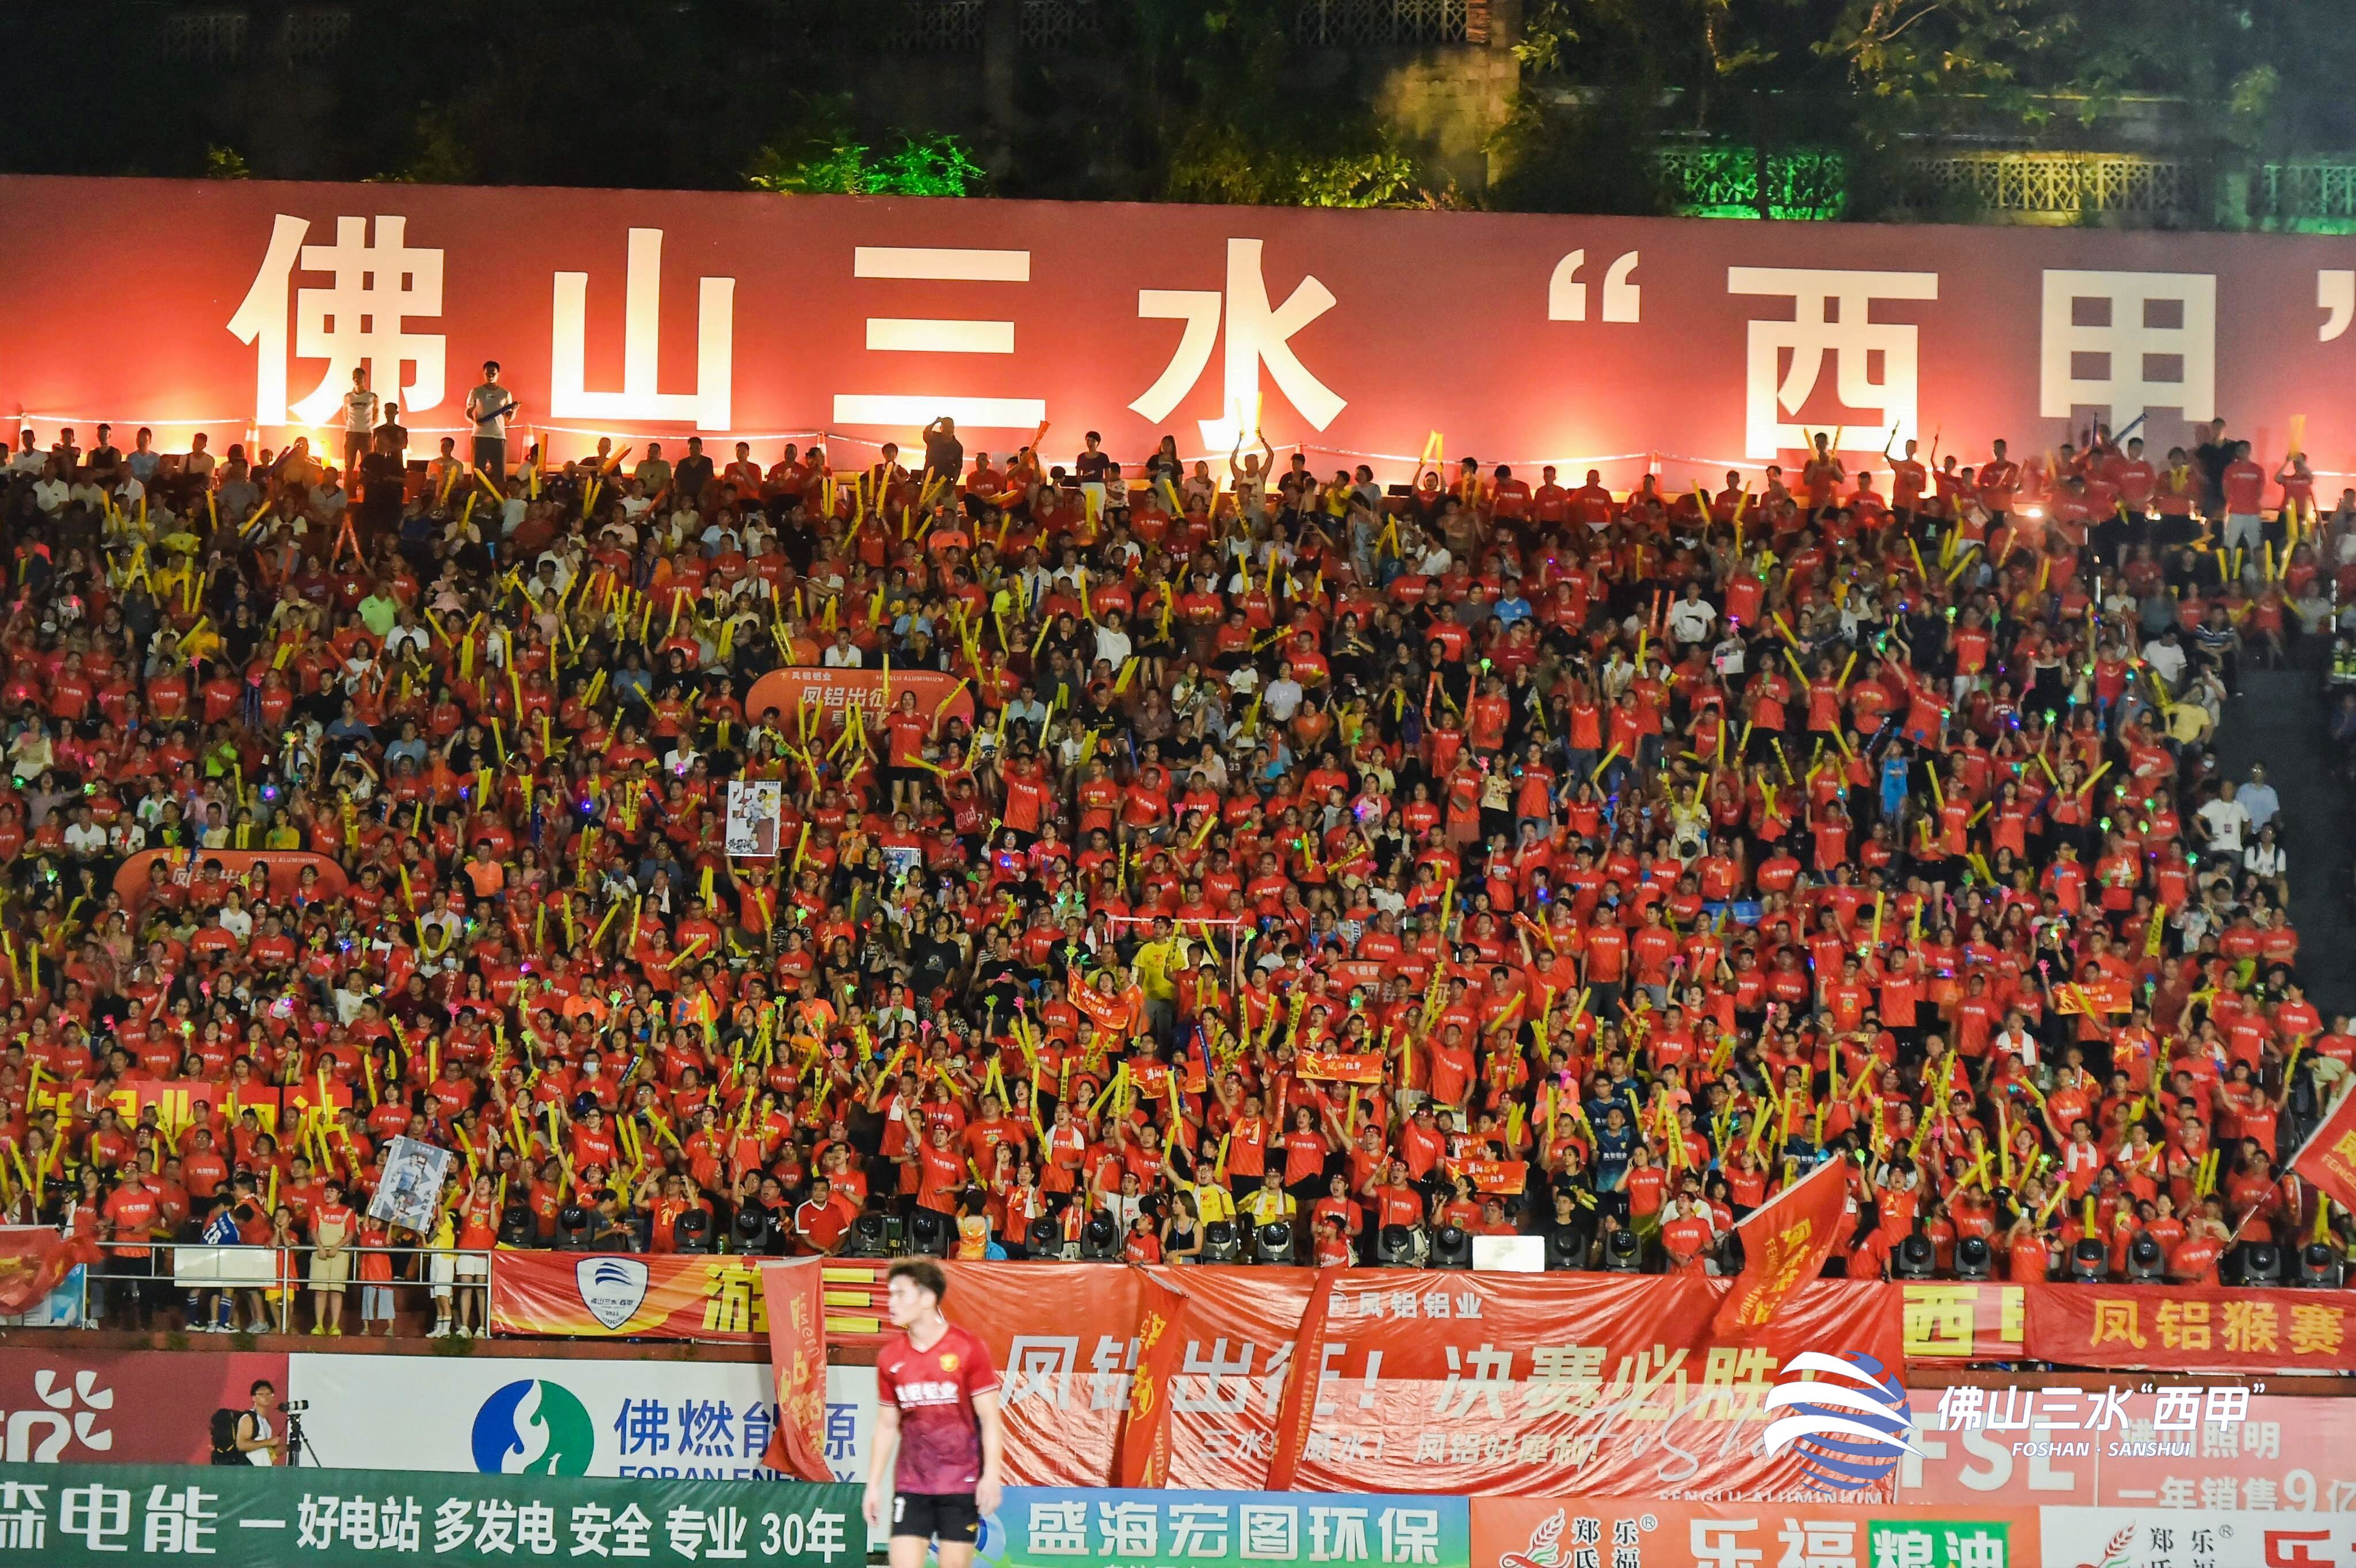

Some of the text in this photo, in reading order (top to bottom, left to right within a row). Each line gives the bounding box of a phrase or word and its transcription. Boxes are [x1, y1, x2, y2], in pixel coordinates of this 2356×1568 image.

[1360, 1292, 1483, 1319] 凤铝铝业
[2090, 1298, 2344, 1355] 凤铝猴赛
[1902, 1412, 2075, 1491] FSL
[297, 1493, 422, 1552] 好电站
[433, 1498, 557, 1555] 多发电
[569, 1502, 652, 1557] 安全
[666, 1504, 747, 1560] 专业
[760, 1508, 846, 1565] 30年
[1027, 1501, 1440, 1565] 盛海宏图环保
